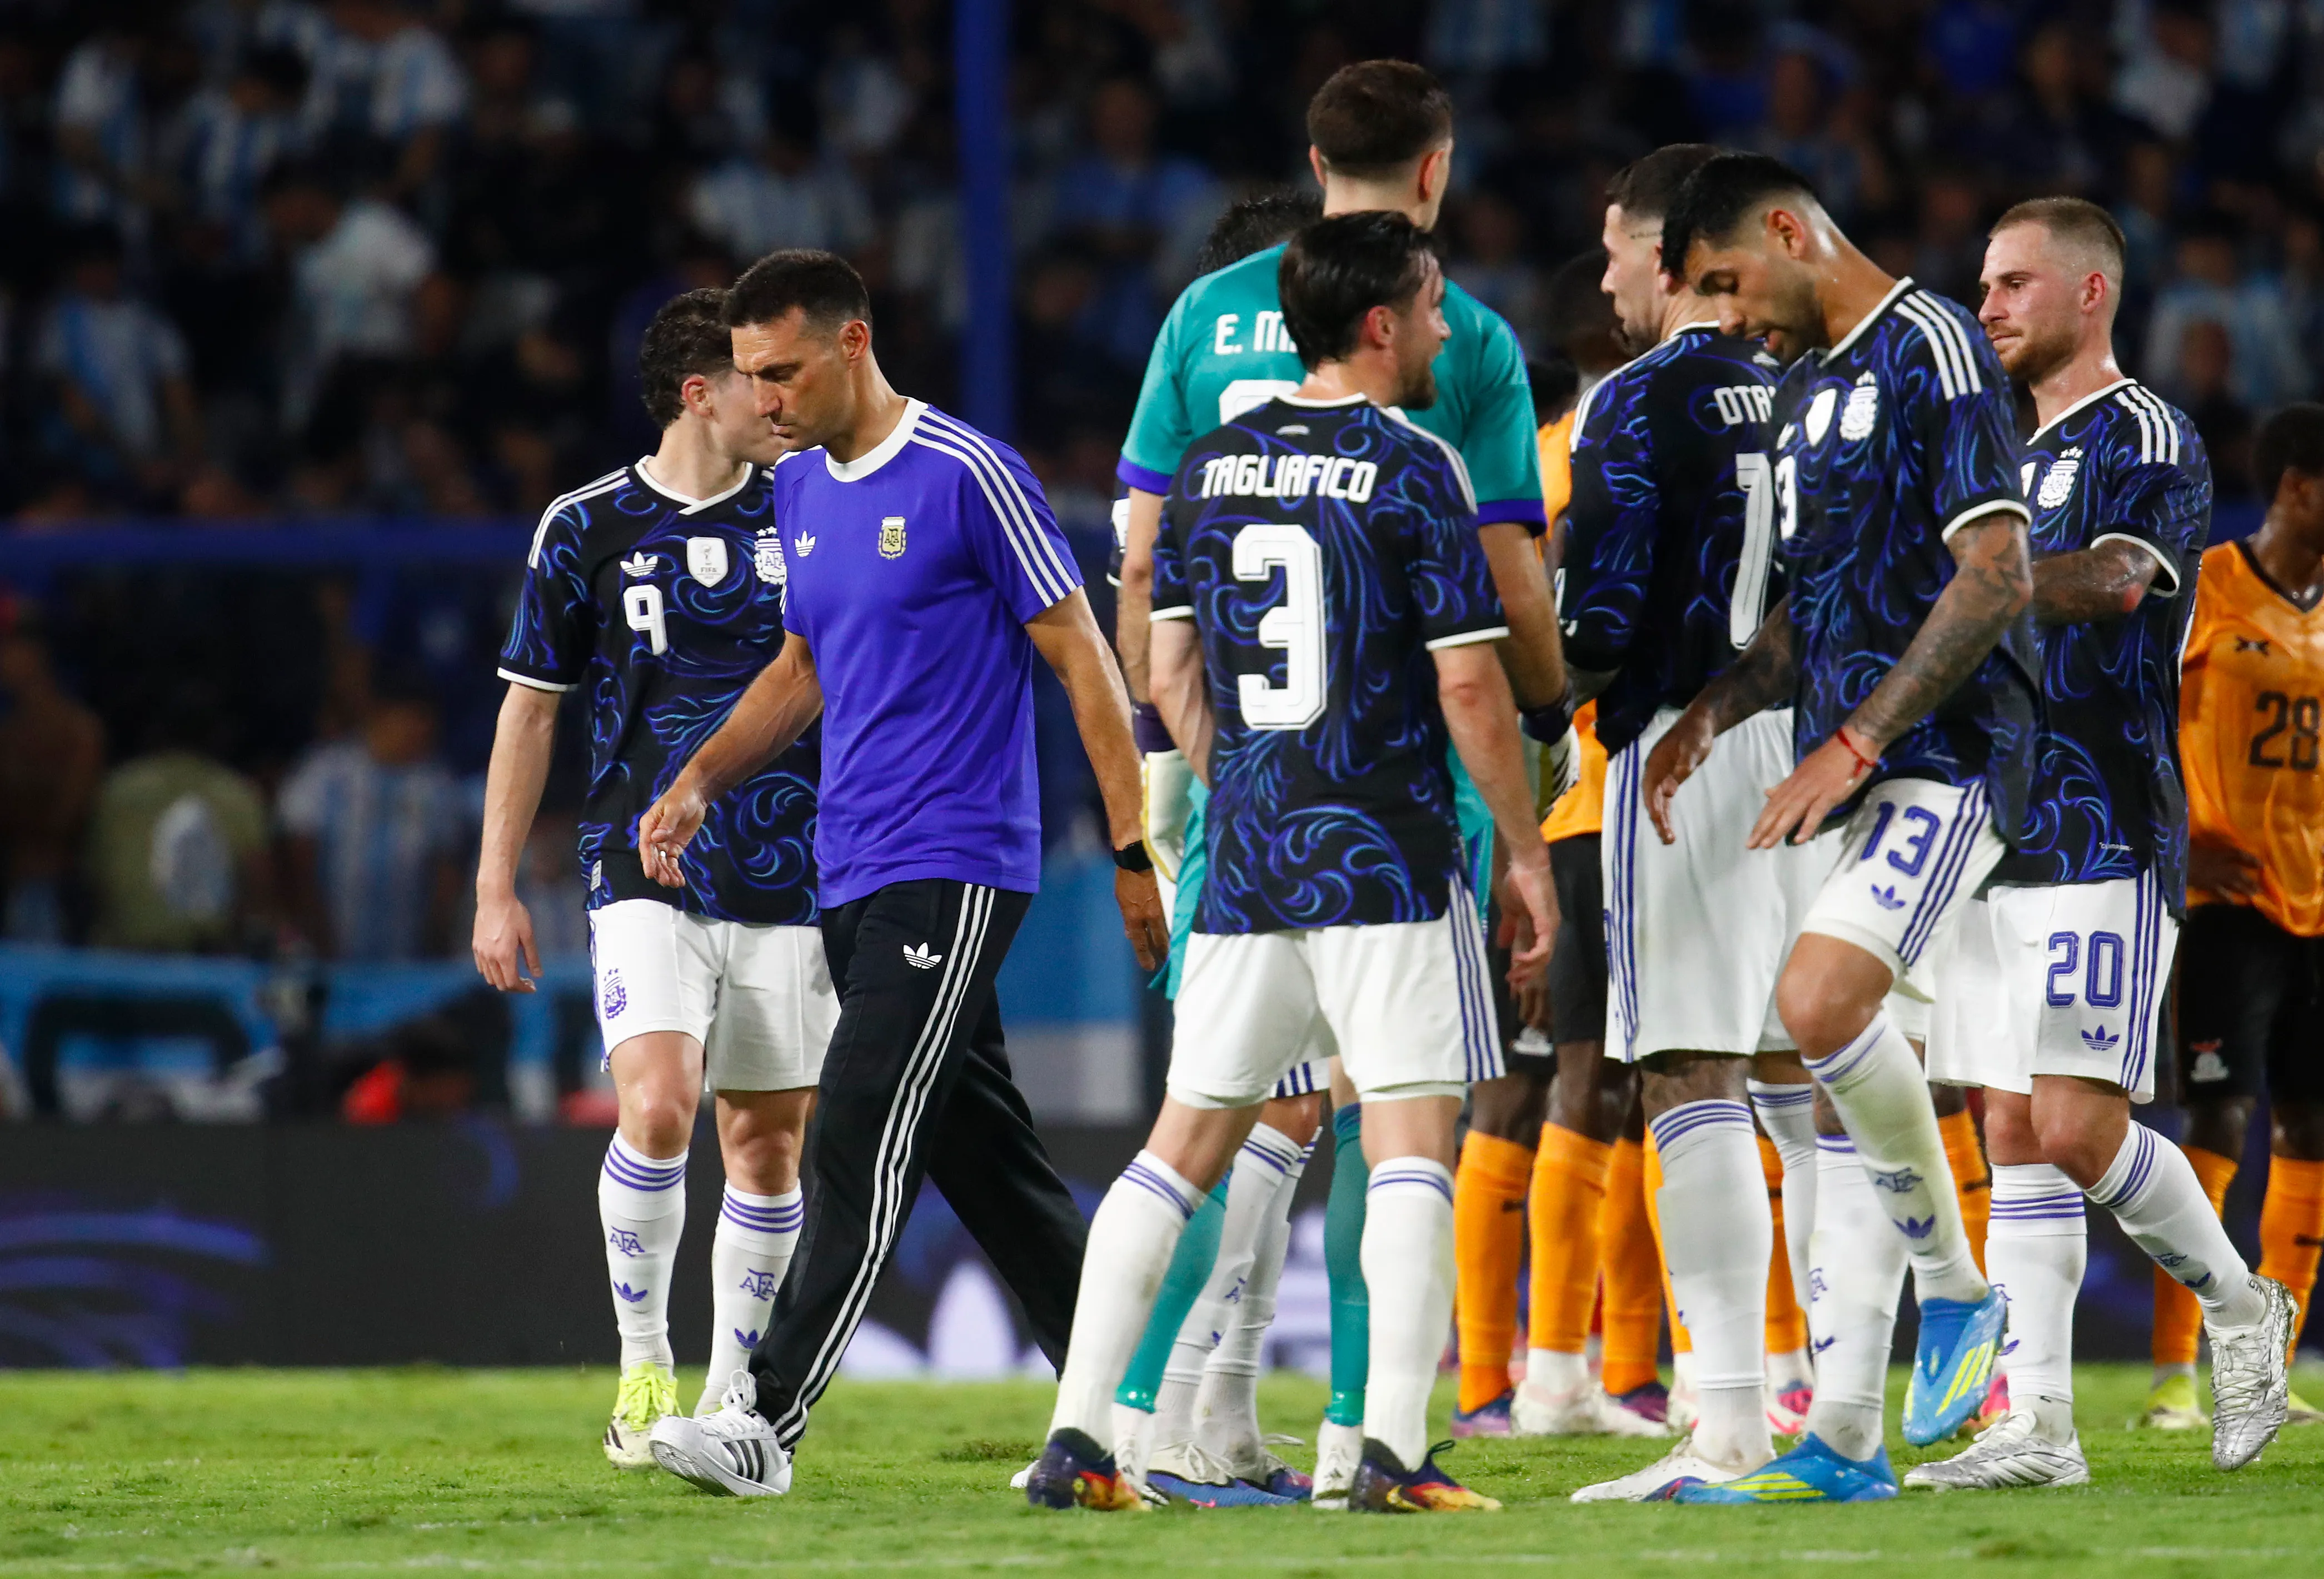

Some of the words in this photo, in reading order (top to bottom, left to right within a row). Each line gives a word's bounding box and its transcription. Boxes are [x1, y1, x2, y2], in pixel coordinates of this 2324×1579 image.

[1214, 313, 1243, 355] E.
[1254, 311, 1298, 353] M
[1714, 385, 1776, 425] OTA
[1200, 454, 1378, 504] TAGLIAFICO
[623, 584, 668, 656] 9
[1232, 524, 1328, 730] 3
[2249, 692, 2320, 771] 28
[1861, 801, 1941, 877] 13
[2046, 930, 2124, 1010] 20
[610, 1226, 645, 1257] AFA
[740, 1268, 777, 1301] AFA
